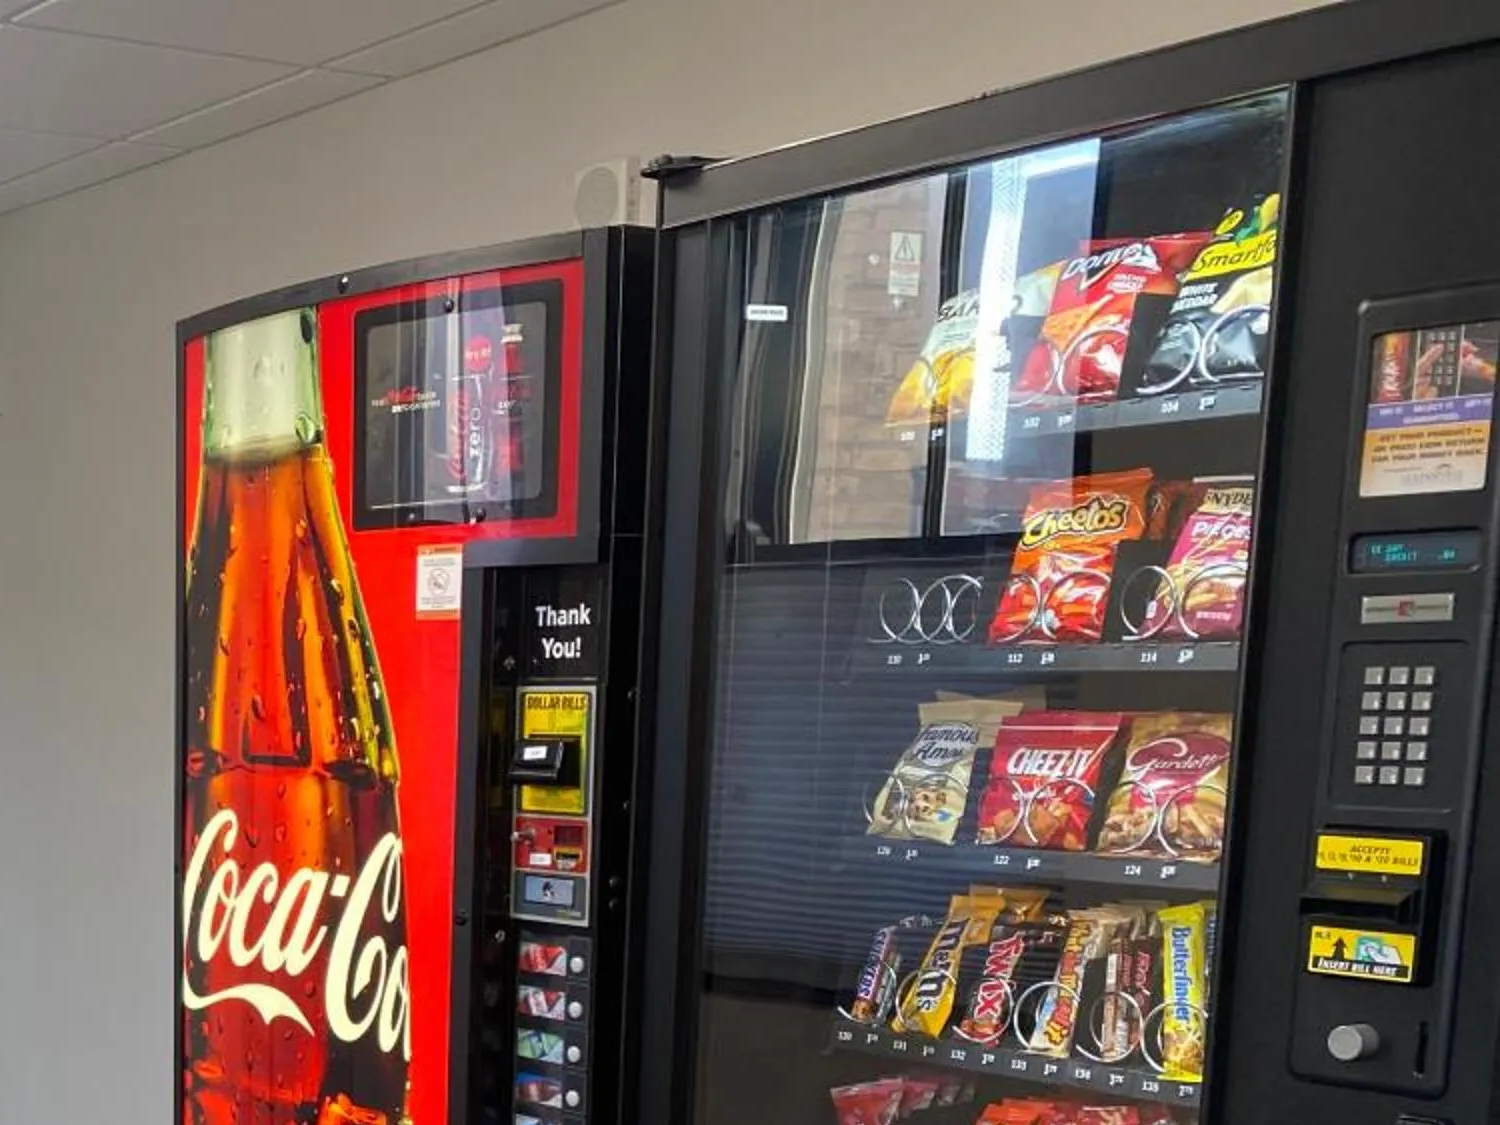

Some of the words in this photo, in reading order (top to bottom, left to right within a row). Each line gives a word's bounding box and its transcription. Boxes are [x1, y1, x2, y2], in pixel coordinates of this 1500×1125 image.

[1022, 500, 1126, 546] Cheetos
[535, 603, 591, 627] Thank
[541, 637, 581, 659] You!
[527, 695, 561, 711] DOLLAR
[562, 695, 586, 711] BILLS
[1170, 926, 1194, 1023] Butterfinger
